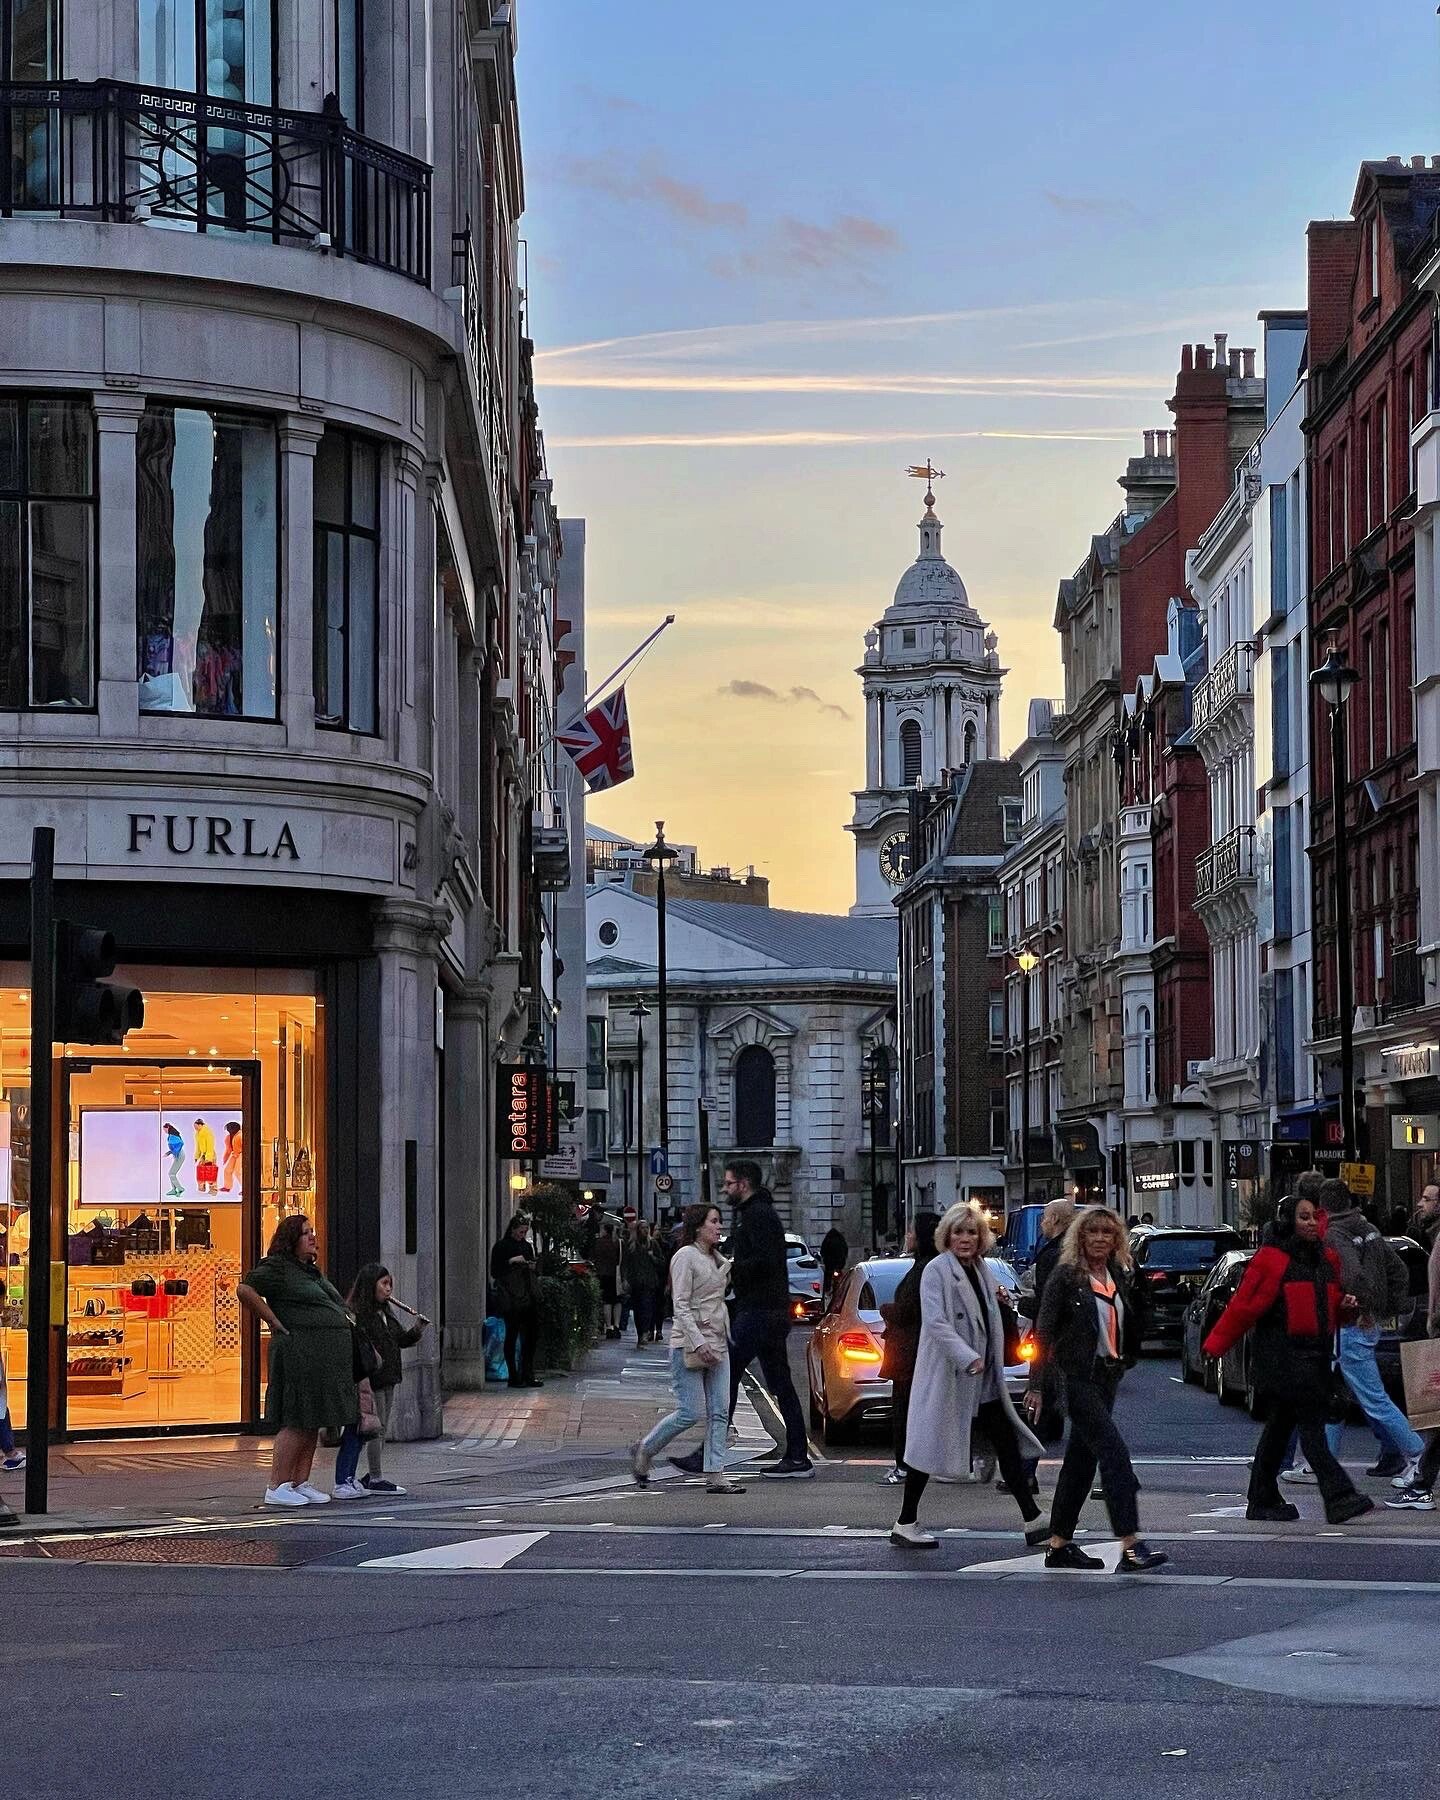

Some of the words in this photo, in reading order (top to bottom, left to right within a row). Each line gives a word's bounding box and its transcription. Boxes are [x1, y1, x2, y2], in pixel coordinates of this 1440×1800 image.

[127, 813, 300, 860] FURLA
[508, 1072, 530, 1151] patara
[1314, 1149, 1346, 1159] KARAOKE
[659, 1178, 670, 1186] 20
